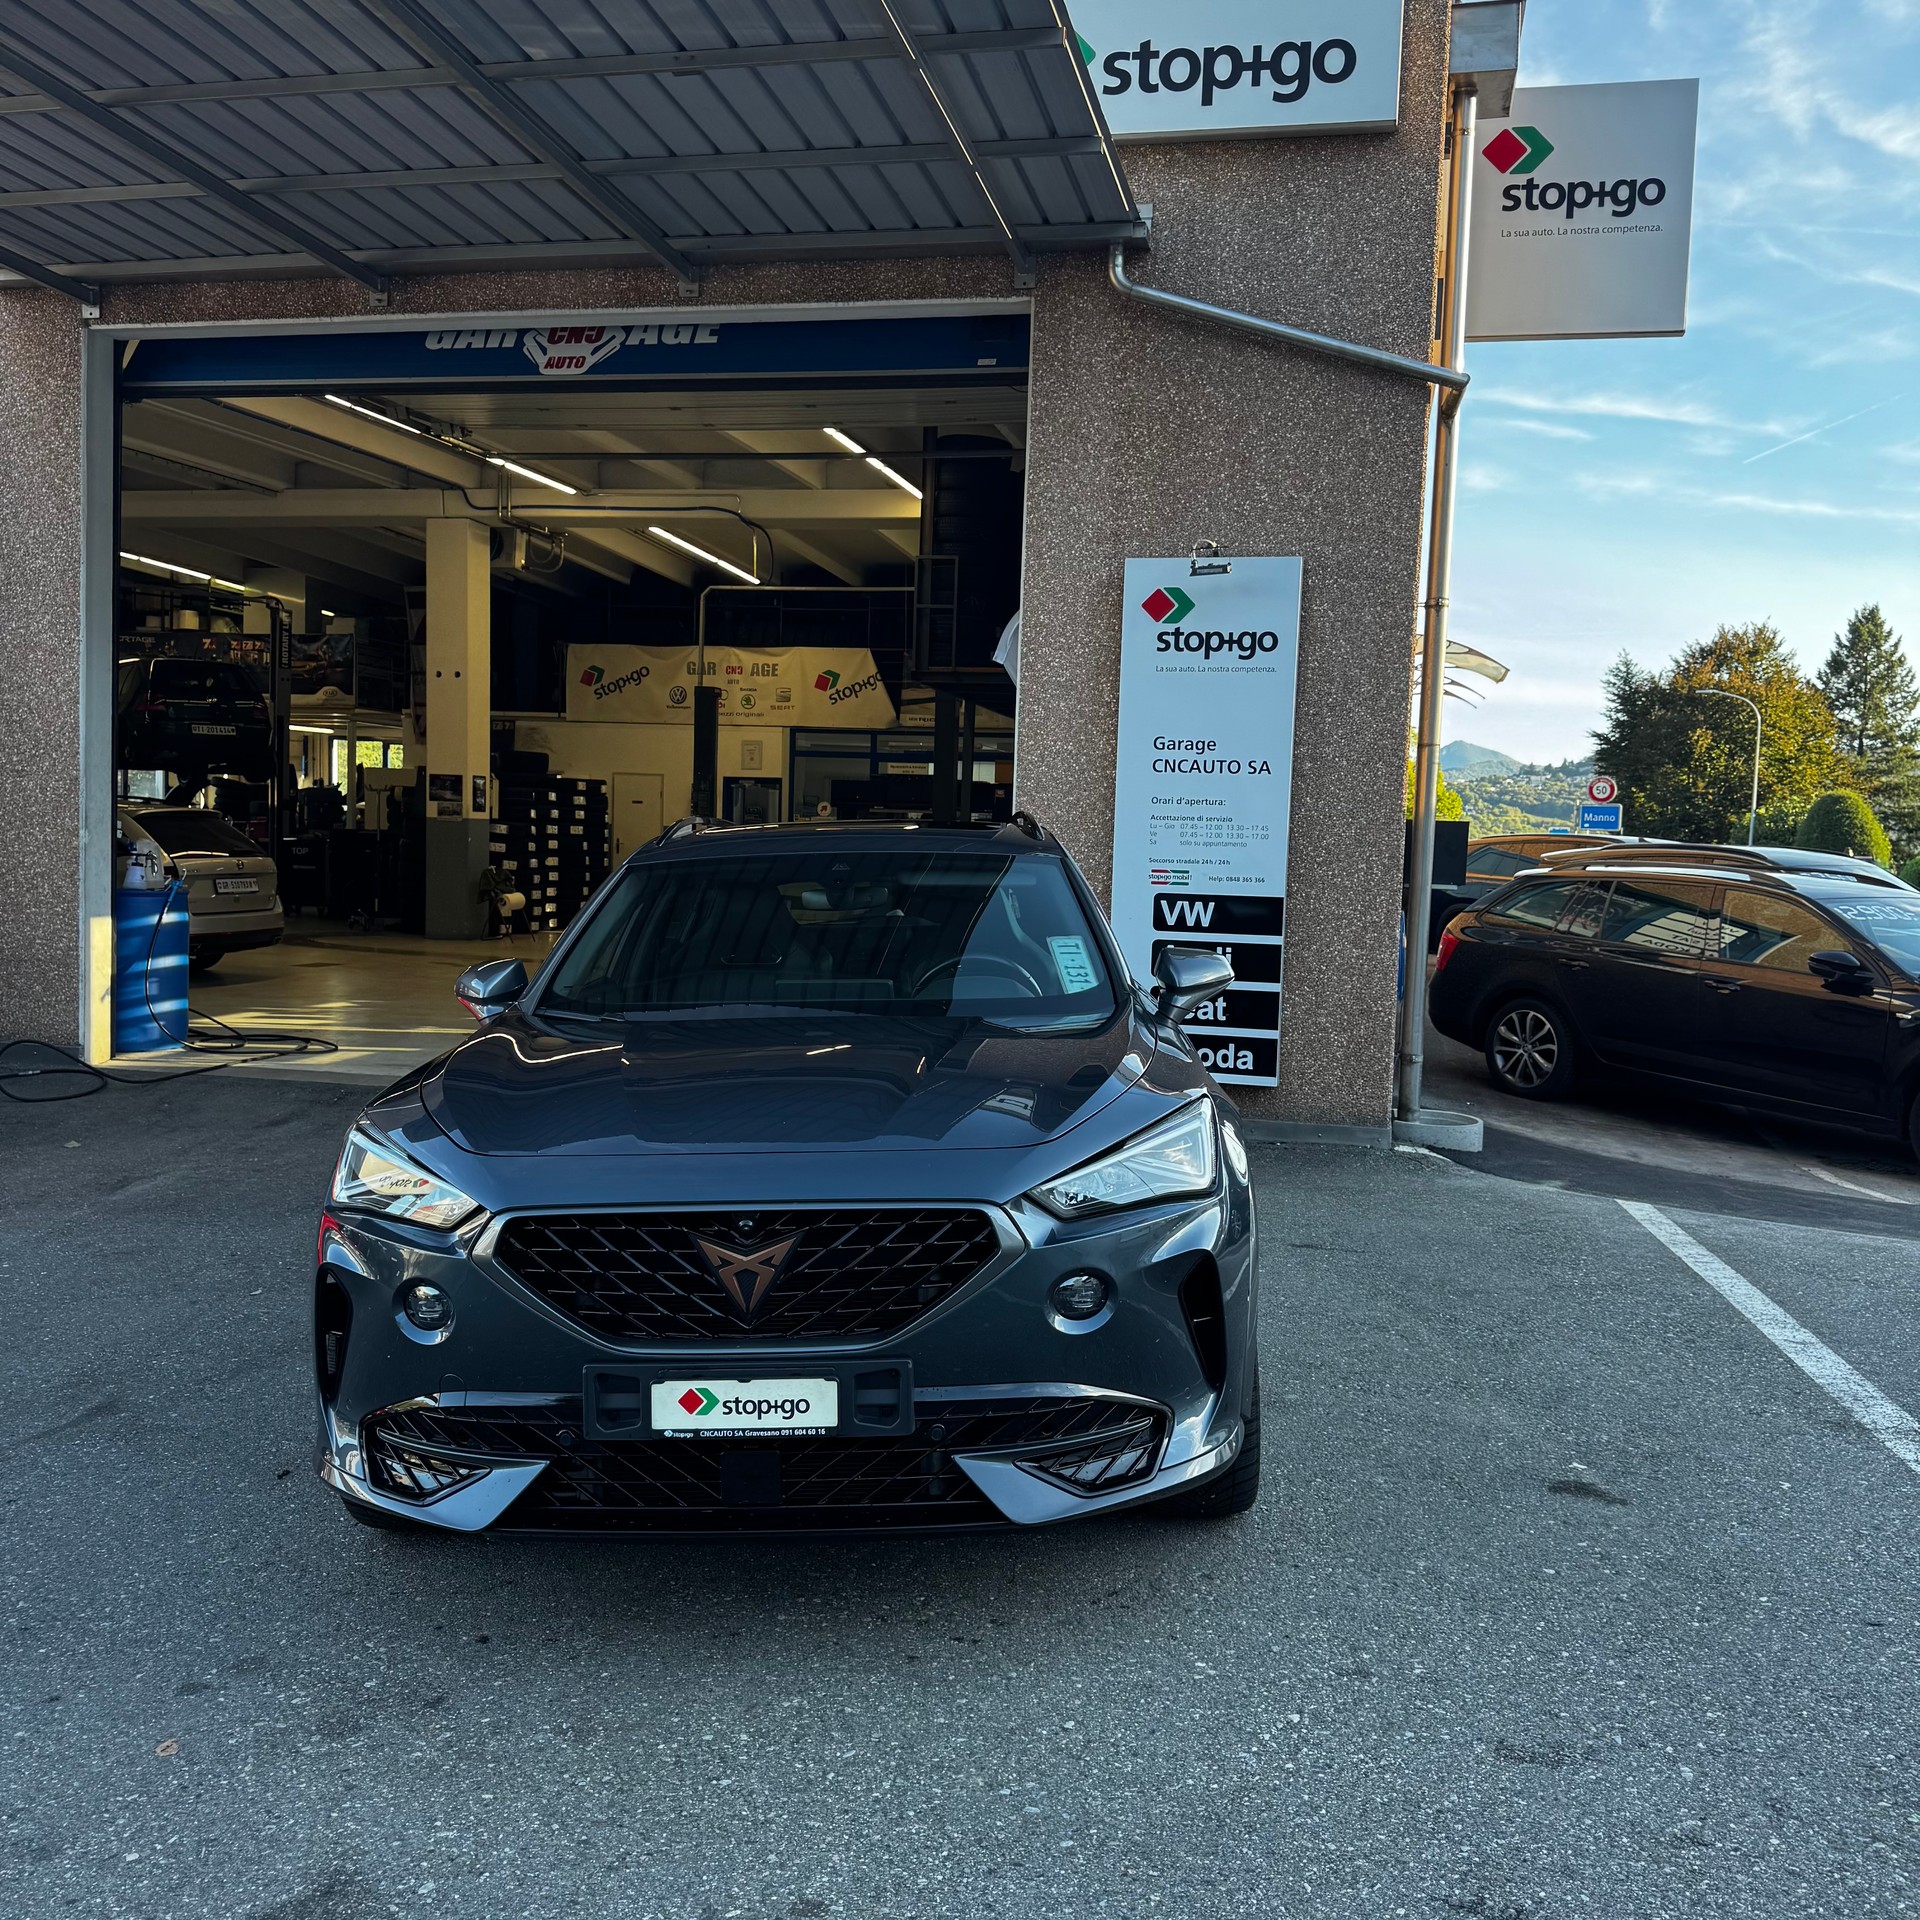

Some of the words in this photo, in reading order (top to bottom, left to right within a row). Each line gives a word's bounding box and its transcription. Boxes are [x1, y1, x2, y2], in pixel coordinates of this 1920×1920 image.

[1102, 38, 1357, 106] stop+go
[1501, 176, 1666, 219] stop+go
[1501, 229, 1511, 238] La
[1532, 228, 1555, 237] auto.
[1558, 227, 1568, 236] La
[1570, 226, 1600, 235] nostra
[1602, 224, 1663, 235] competenza.
[544, 356, 586, 369] AUTO
[1156, 626, 1279, 660] stop+go
[687, 661, 717, 675] GAR
[750, 663, 779, 677] AGE
[1156, 665, 1164, 673] La
[1198, 665, 1206, 673] La
[1231, 666, 1277, 674] competenza.
[594, 666, 650, 700] stop+go
[1153, 736, 1217, 754] Garage
[1152, 758, 1241, 774] CNCAUTO
[1248, 760, 1272, 775] SA
[1596, 785, 1608, 795] 50
[1151, 796, 1174, 805] Orari
[1176, 796, 1226, 807] d'apertura:
[1150, 814, 1195, 822] Accettazione
[1205, 815, 1233, 823] servizio
[1583, 812, 1616, 822] Manno
[1148, 873, 1172, 881] stop+go
[1208, 875, 1225, 883] Help:
[1160, 900, 1215, 927] VW
[1199, 1043, 1254, 1070] oda
[722, 1396, 811, 1420] stop+go
[745, 1429, 780, 1437] Gravesano
[794, 1428, 807, 1436] 604
